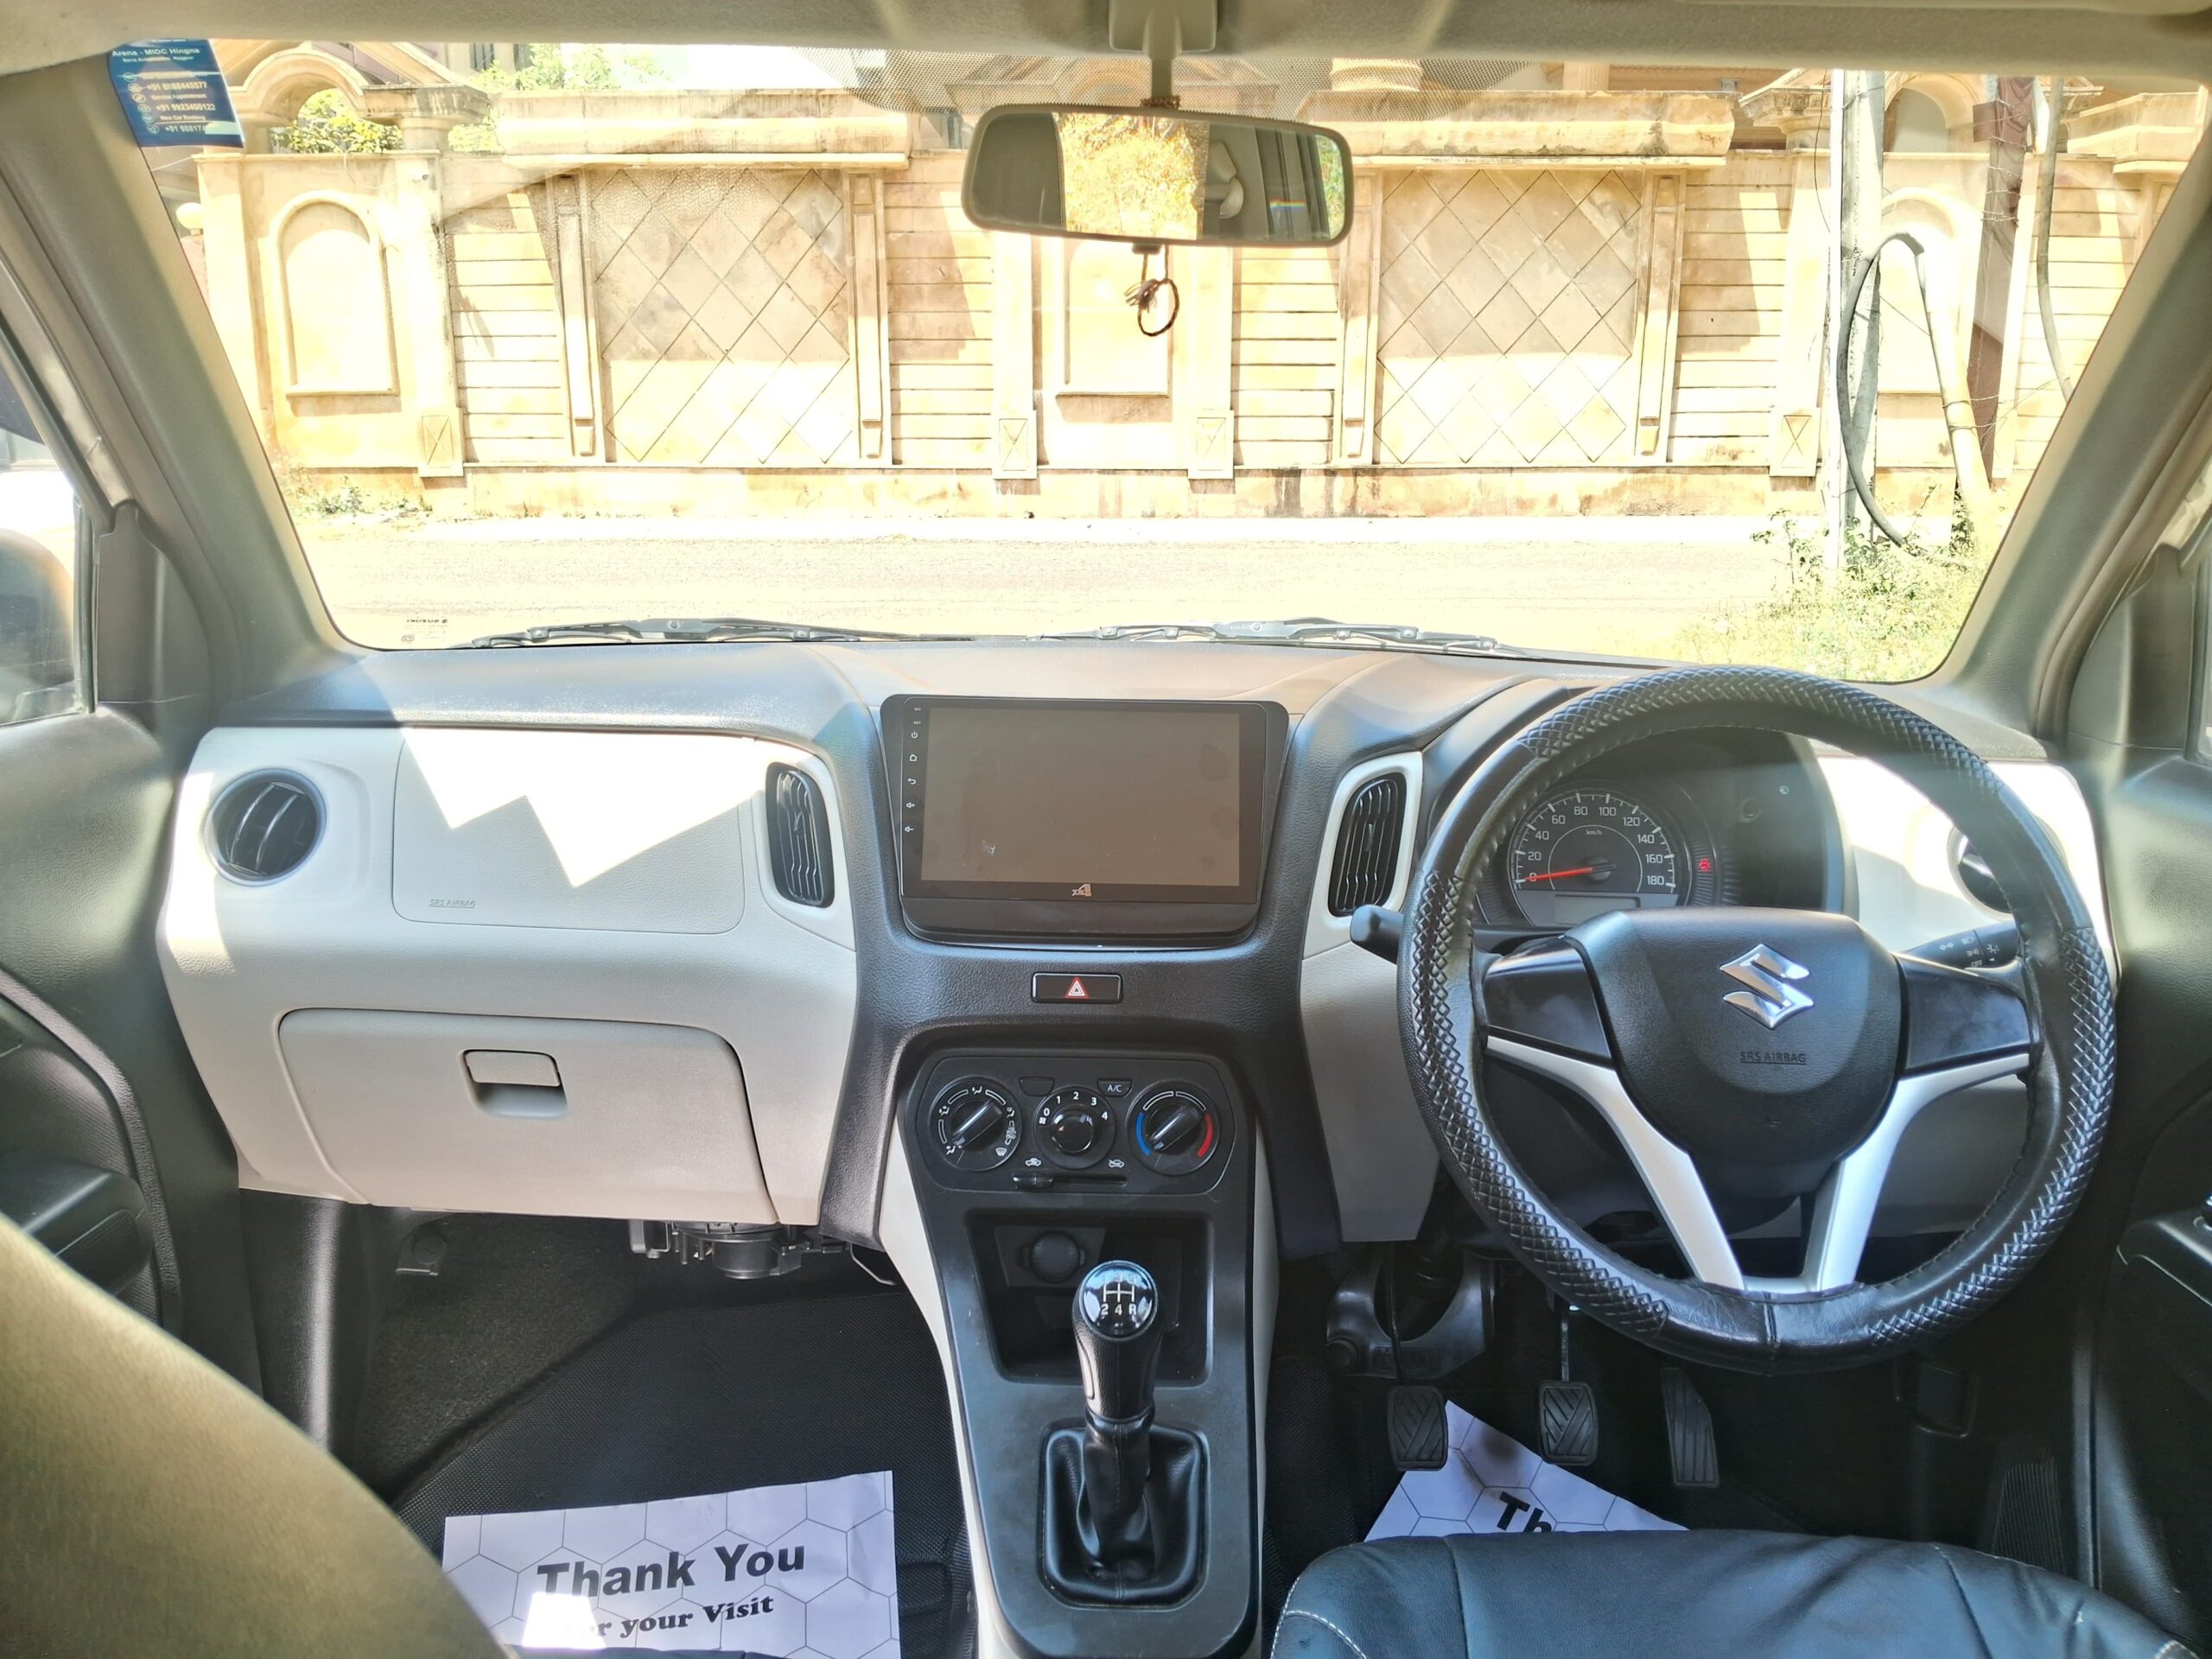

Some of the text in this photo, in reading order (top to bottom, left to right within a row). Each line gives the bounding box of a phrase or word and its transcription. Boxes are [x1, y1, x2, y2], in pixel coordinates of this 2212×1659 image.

[1574, 806, 1587, 816] 80
[1599, 806, 1617, 817] 100
[1552, 815, 1566, 824] 60
[1623, 817, 1640, 827] 120
[1535, 830, 1549, 840] 40
[1637, 835, 1655, 844] 140
[1528, 851, 1541, 861] 20
[1645, 854, 1663, 863] 160
[1647, 875, 1664, 886] 180
[1740, 1052, 1806, 1063] SRS AIRBAG
[1056, 1096, 1061, 1104] 1
[1073, 1091, 1079, 1101] 2
[1090, 1097, 1097, 1106] 3
[1044, 1108, 1050, 1116] 0
[1102, 1111, 1109, 1120] 4
[1101, 1303, 1109, 1315] 2
[1115, 1304, 1122, 1316] 4
[1128, 1303, 1136, 1315] R
[536, 1543, 805, 1599] Thank You
[620, 1610, 694, 1640] your
[702, 1595, 774, 1624] Visit
